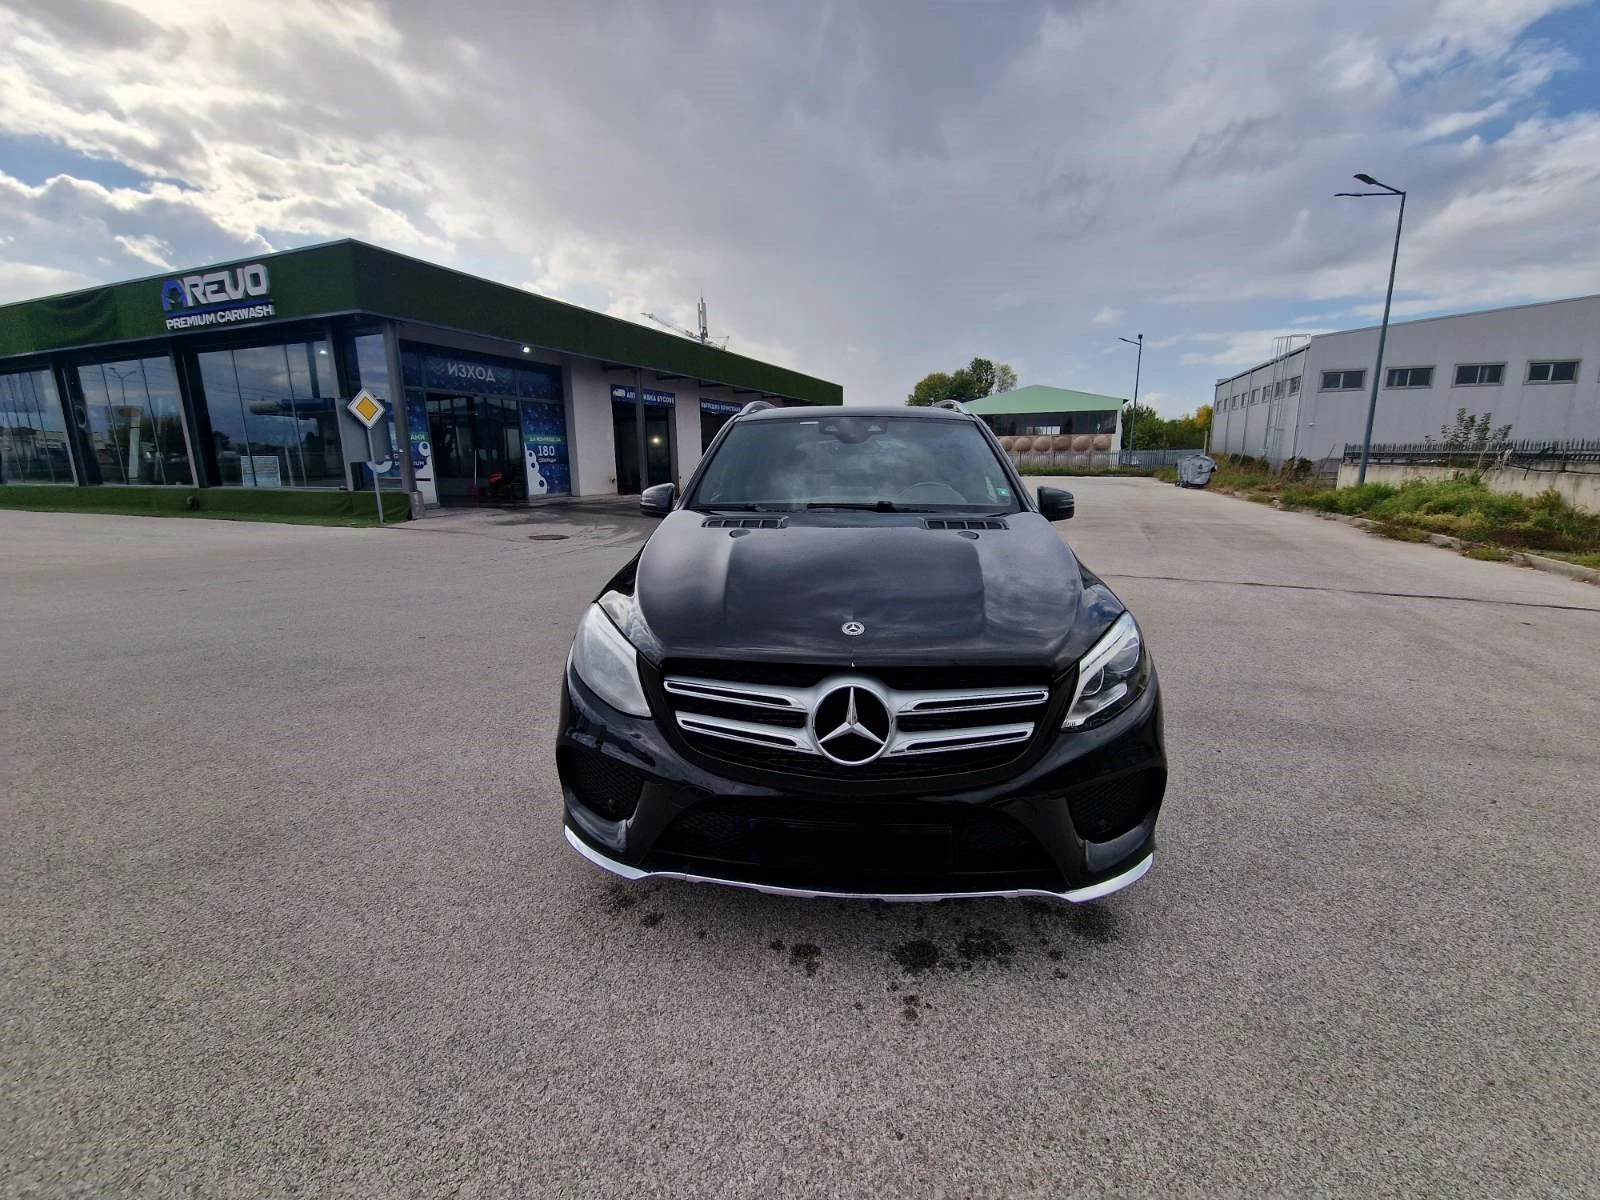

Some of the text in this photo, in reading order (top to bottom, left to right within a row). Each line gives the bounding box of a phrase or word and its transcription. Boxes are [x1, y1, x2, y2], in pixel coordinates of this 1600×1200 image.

[166, 304, 274, 330] PREMIUM CARWASH
[447, 360, 496, 383] ИЗХОД
[538, 445, 555, 456] 180
